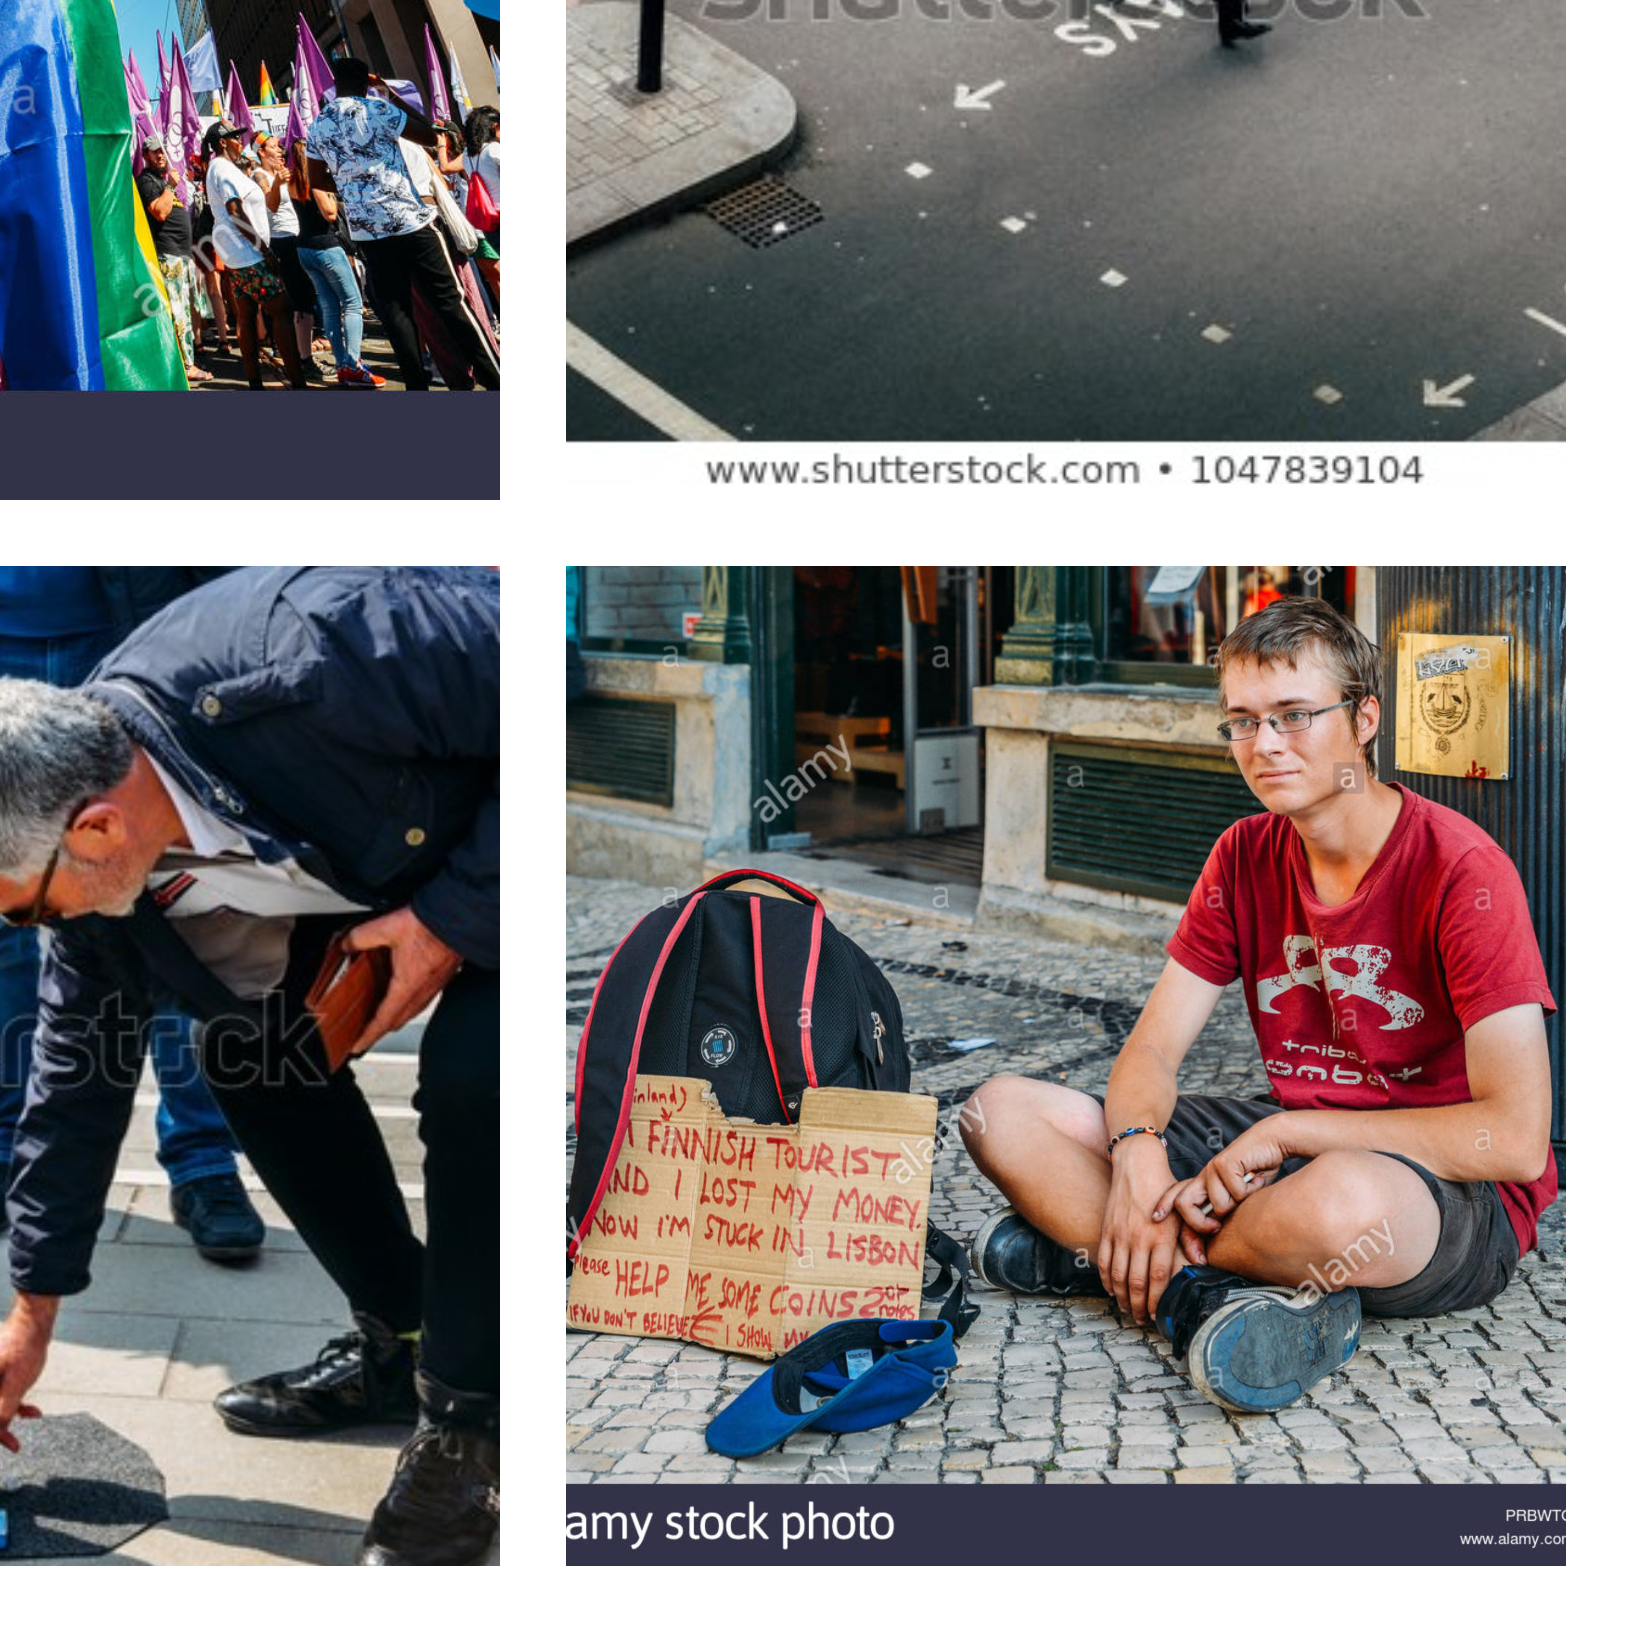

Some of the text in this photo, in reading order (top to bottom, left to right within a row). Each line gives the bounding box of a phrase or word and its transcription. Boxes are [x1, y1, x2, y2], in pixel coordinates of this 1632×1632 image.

[648, 1119, 757, 1172] FINNISH
[766, 1136, 901, 1180] TOURIST
[674, 1169, 682, 1201] I
[700, 1171, 757, 1213] LOST
[771, 1184, 814, 1222] MY
[833, 1187, 922, 1232] MONEY.
[587, 1208, 920, 1271] NOW I'M STUCK IN LISBON
[615, 1258, 670, 1299] HELP
[685, 1269, 712, 1310] ME
[718, 1276, 762, 1318] SOME
[769, 1285, 858, 1319] COINS
[879, 1304, 916, 1321] notes
[569, 1303, 579, 1323] IF
[604, 1308, 637, 1330] DON'T
[643, 1312, 689, 1337] BELIEVE
[737, 1323, 773, 1351] SHOW
